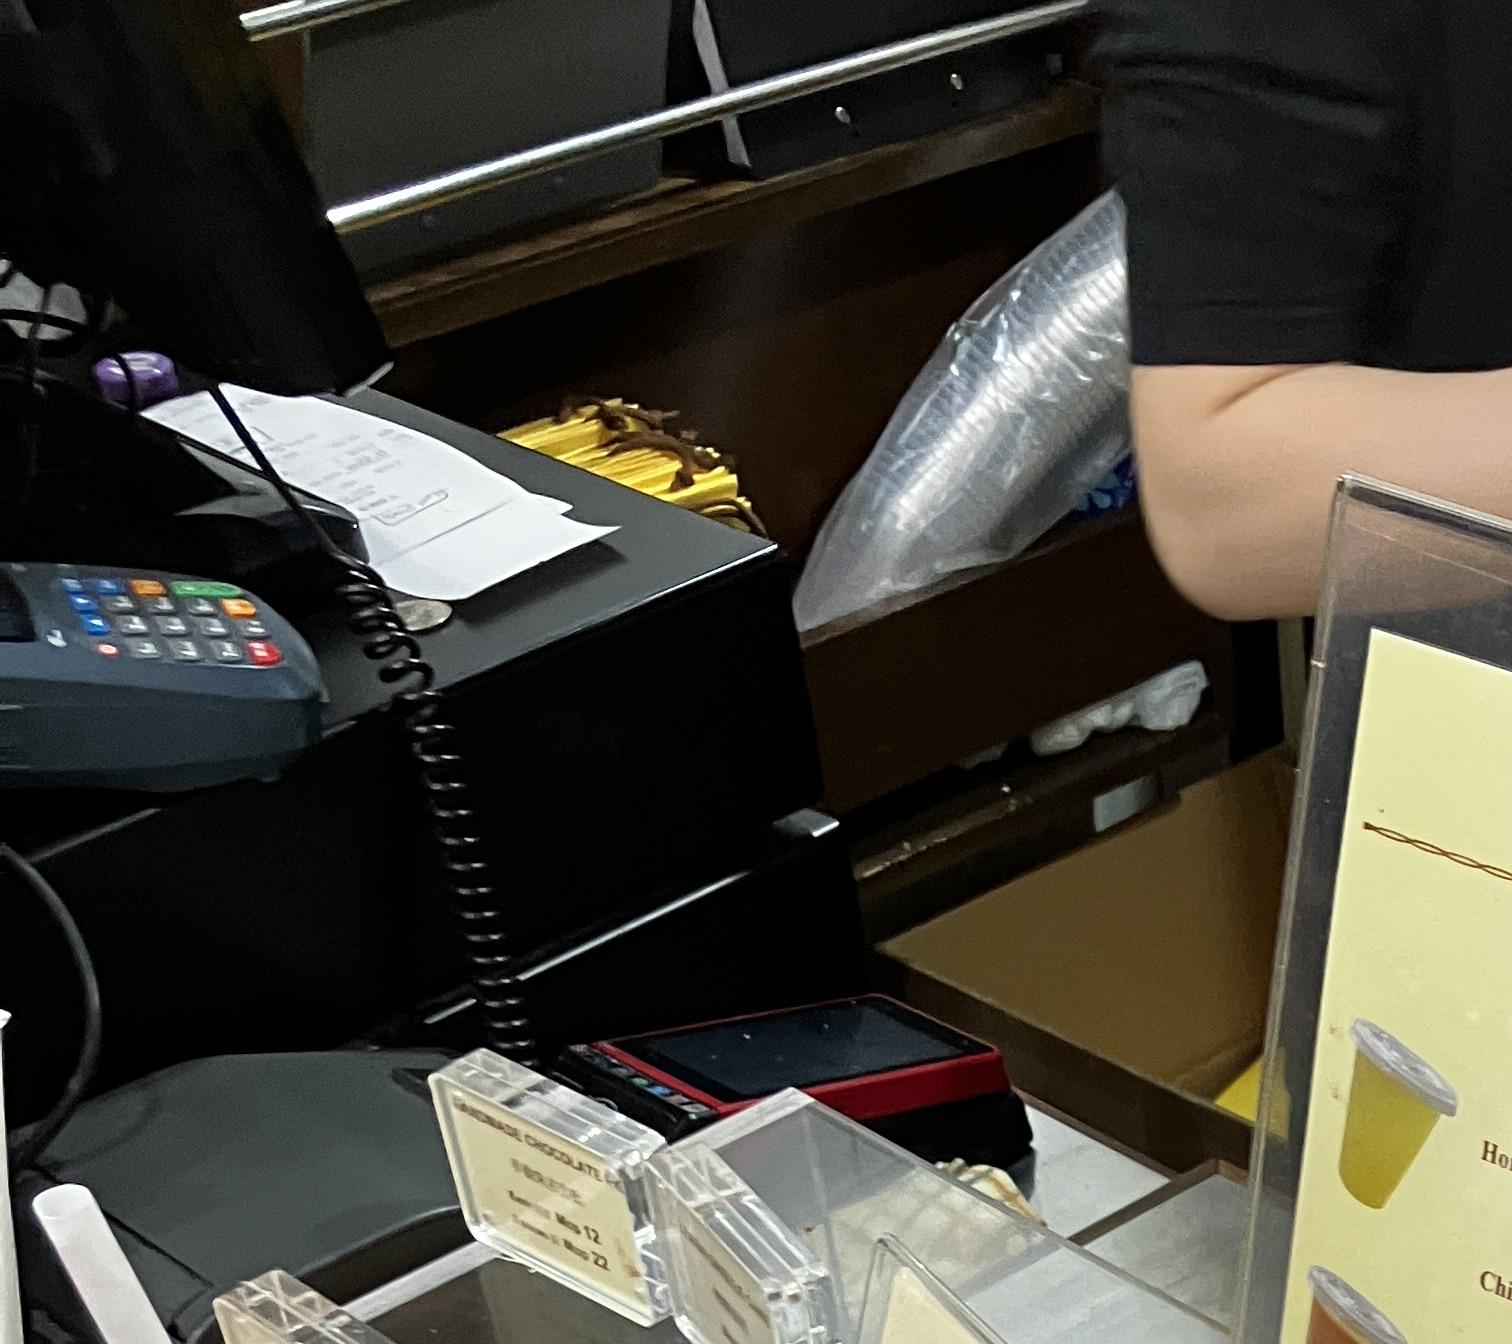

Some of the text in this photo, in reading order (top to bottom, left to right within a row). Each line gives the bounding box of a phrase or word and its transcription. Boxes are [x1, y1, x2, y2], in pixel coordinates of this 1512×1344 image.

[524, 1134, 604, 1182] CHOCOLATE
[583, 1225, 603, 1246] 12
[591, 1251, 612, 1272] 22
